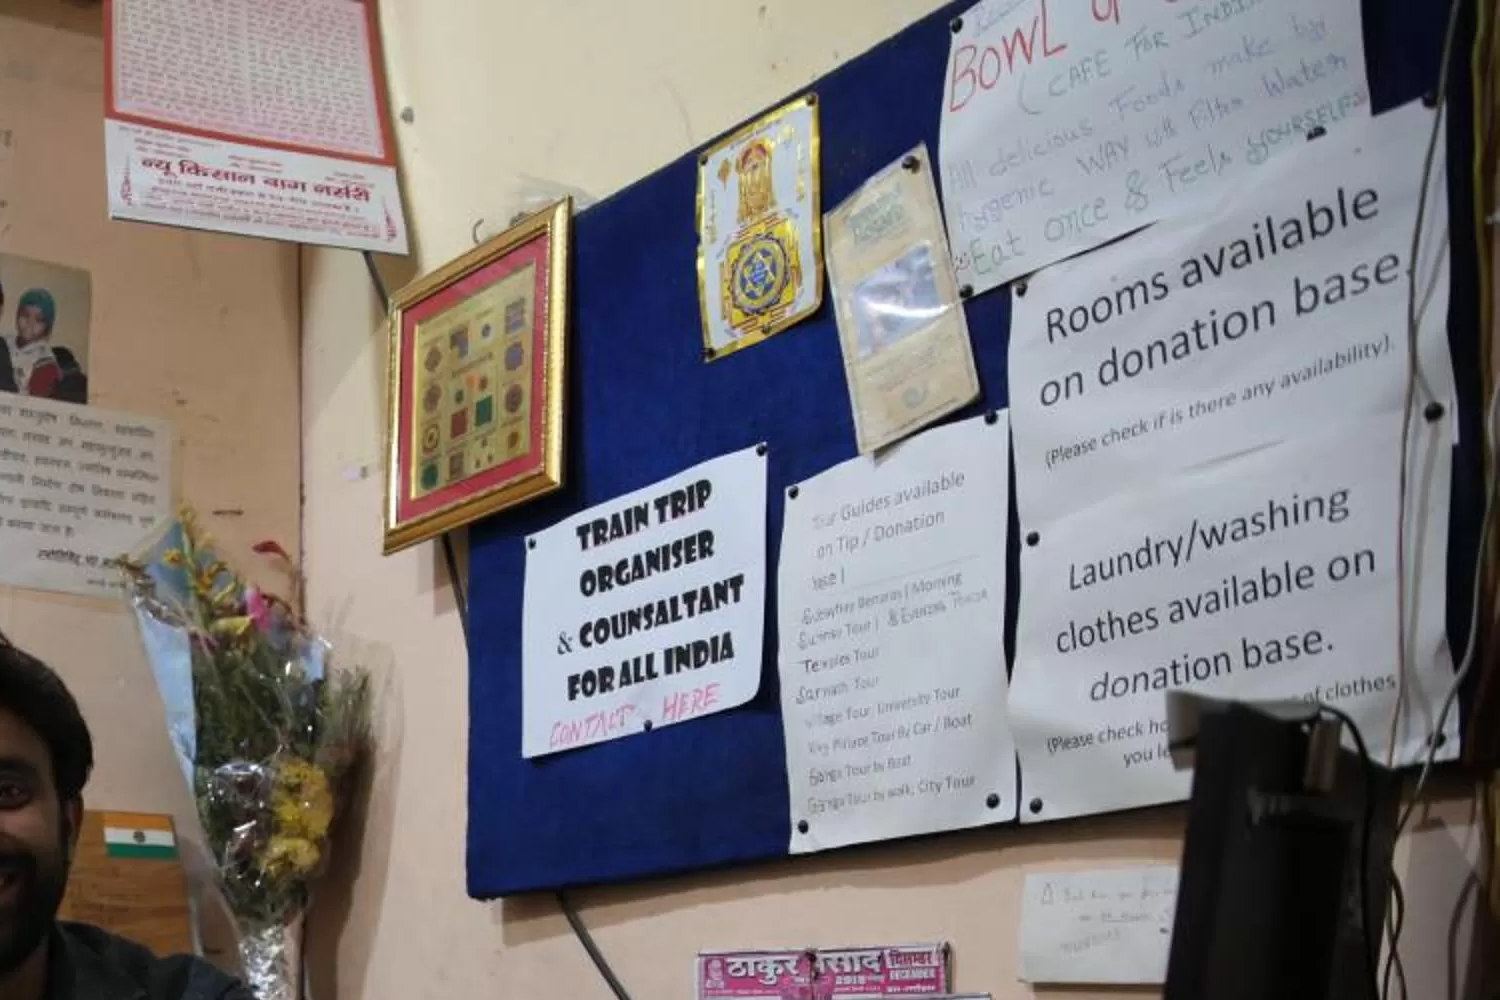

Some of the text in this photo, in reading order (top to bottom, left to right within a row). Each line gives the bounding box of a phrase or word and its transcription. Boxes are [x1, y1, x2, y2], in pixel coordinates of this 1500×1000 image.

[950, 0, 1068, 112] BOWL
[1045, 186, 1381, 345] Rooms available
[1039, 369, 1085, 408] on
[1097, 298, 1277, 387] donation
[1044, 439, 1097, 470] (Please
[1102, 418, 1150, 447] check
[1188, 390, 1238, 420] there
[1241, 379, 1277, 404] any
[576, 478, 713, 551] TRAIN TRIP
[836, 534, 861, 554] Tip
[874, 509, 946, 543] Donation
[841, 494, 892, 523] Guides
[893, 470, 966, 506] available
[579, 529, 715, 597] ORGANISER
[1067, 486, 1352, 592] Laundry/washing
[556, 630, 574, 655] &
[579, 573, 745, 649] COUNSALTANT
[1055, 547, 1377, 655] clothes available on
[567, 631, 735, 701] FOR ALL INDIA
[1089, 627, 1334, 703] donation base.
[549, 683, 721, 749] CONTACT HERE
[1046, 732, 1095, 757] (Please
[1097, 719, 1145, 744] check
[1325, 674, 1397, 702] clothes
[1122, 750, 1154, 769] you
[727, 955, 800, 985] ठाकुर
